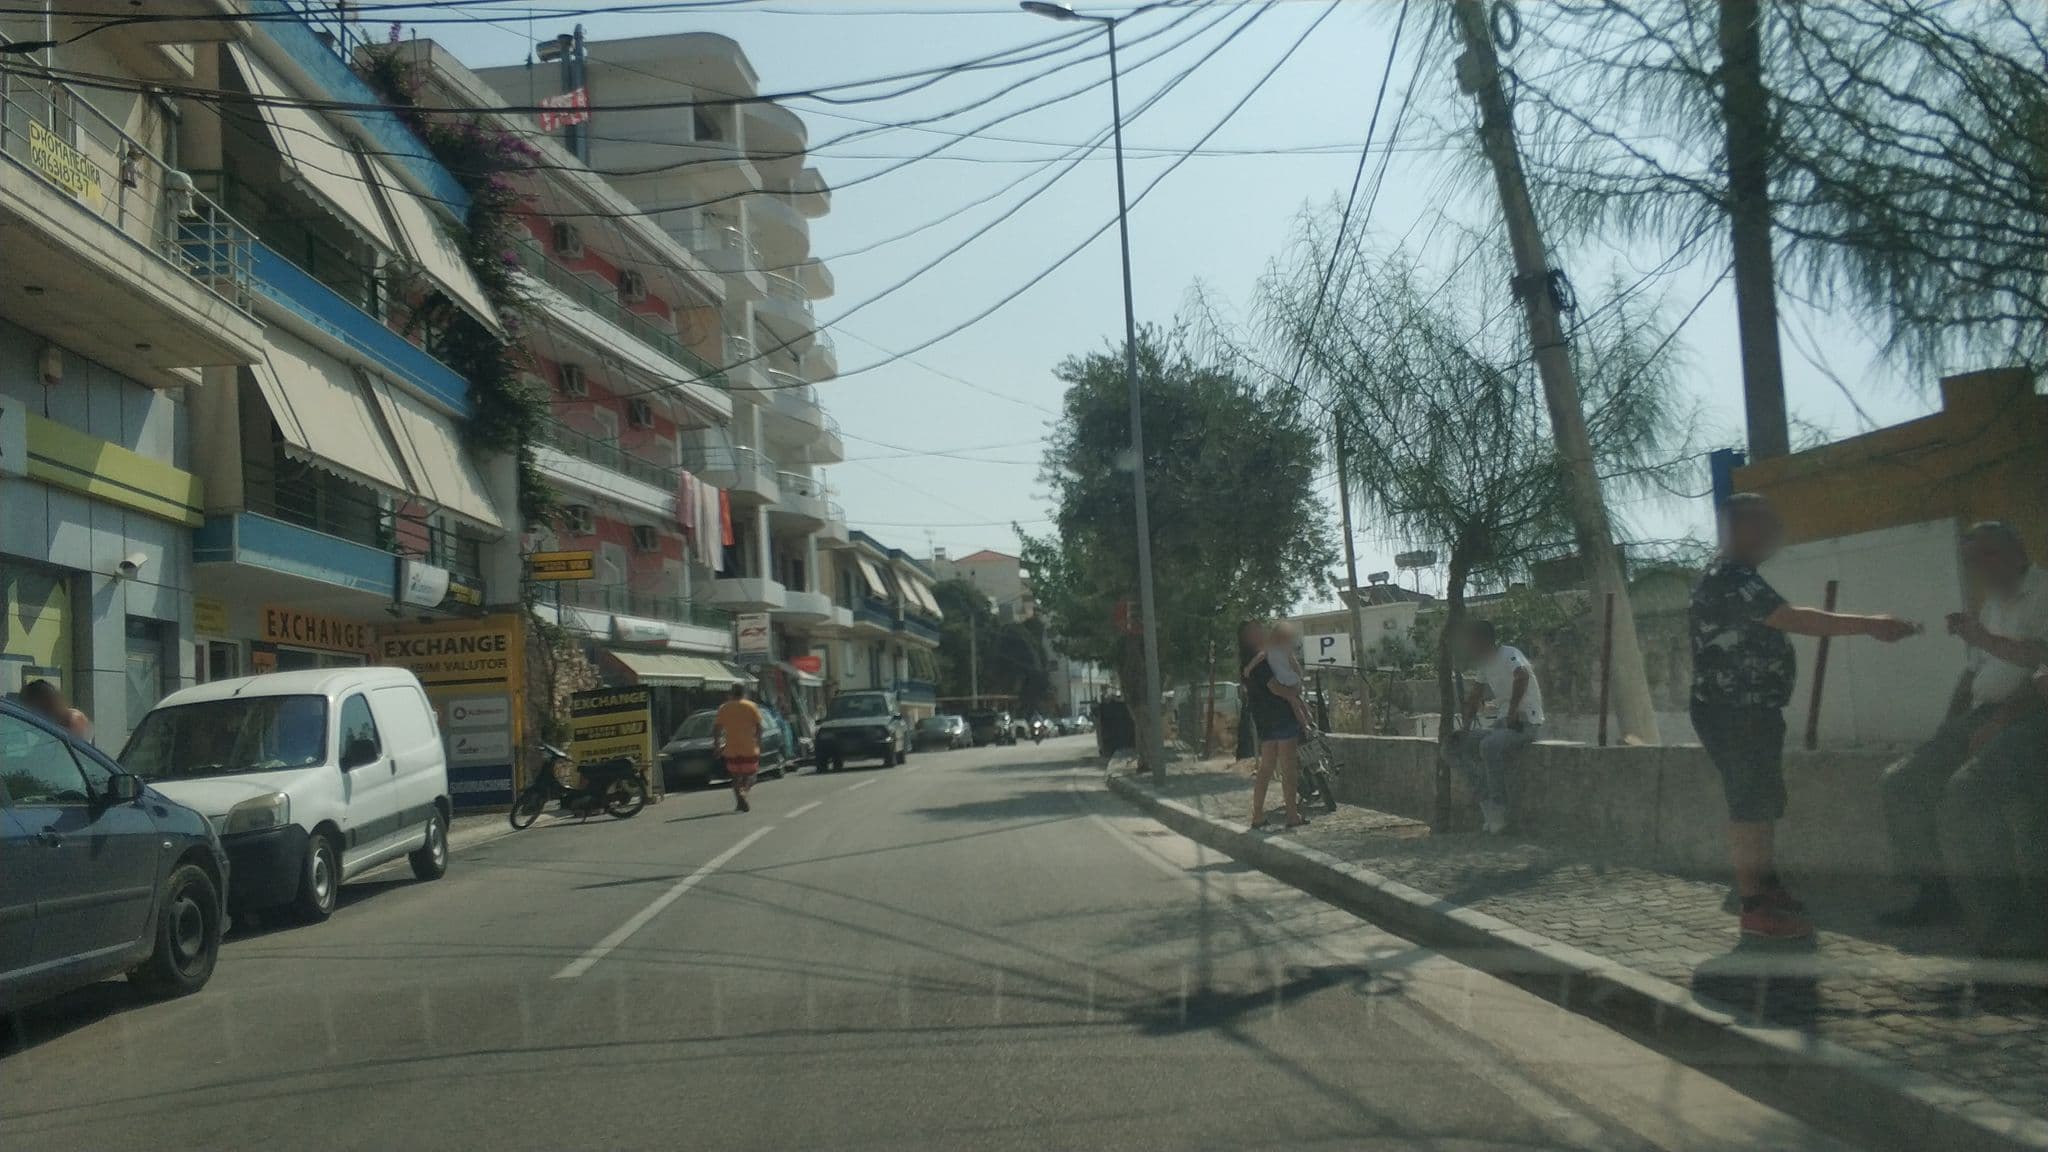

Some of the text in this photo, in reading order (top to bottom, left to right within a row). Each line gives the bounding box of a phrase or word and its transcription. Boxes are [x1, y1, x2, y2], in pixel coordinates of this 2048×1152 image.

[267, 608, 366, 649] EXCHANGE
[384, 634, 507, 658] EXCHANGE
[1320, 636, 1335, 656] P
[574, 690, 649, 710] EXCHANGE
